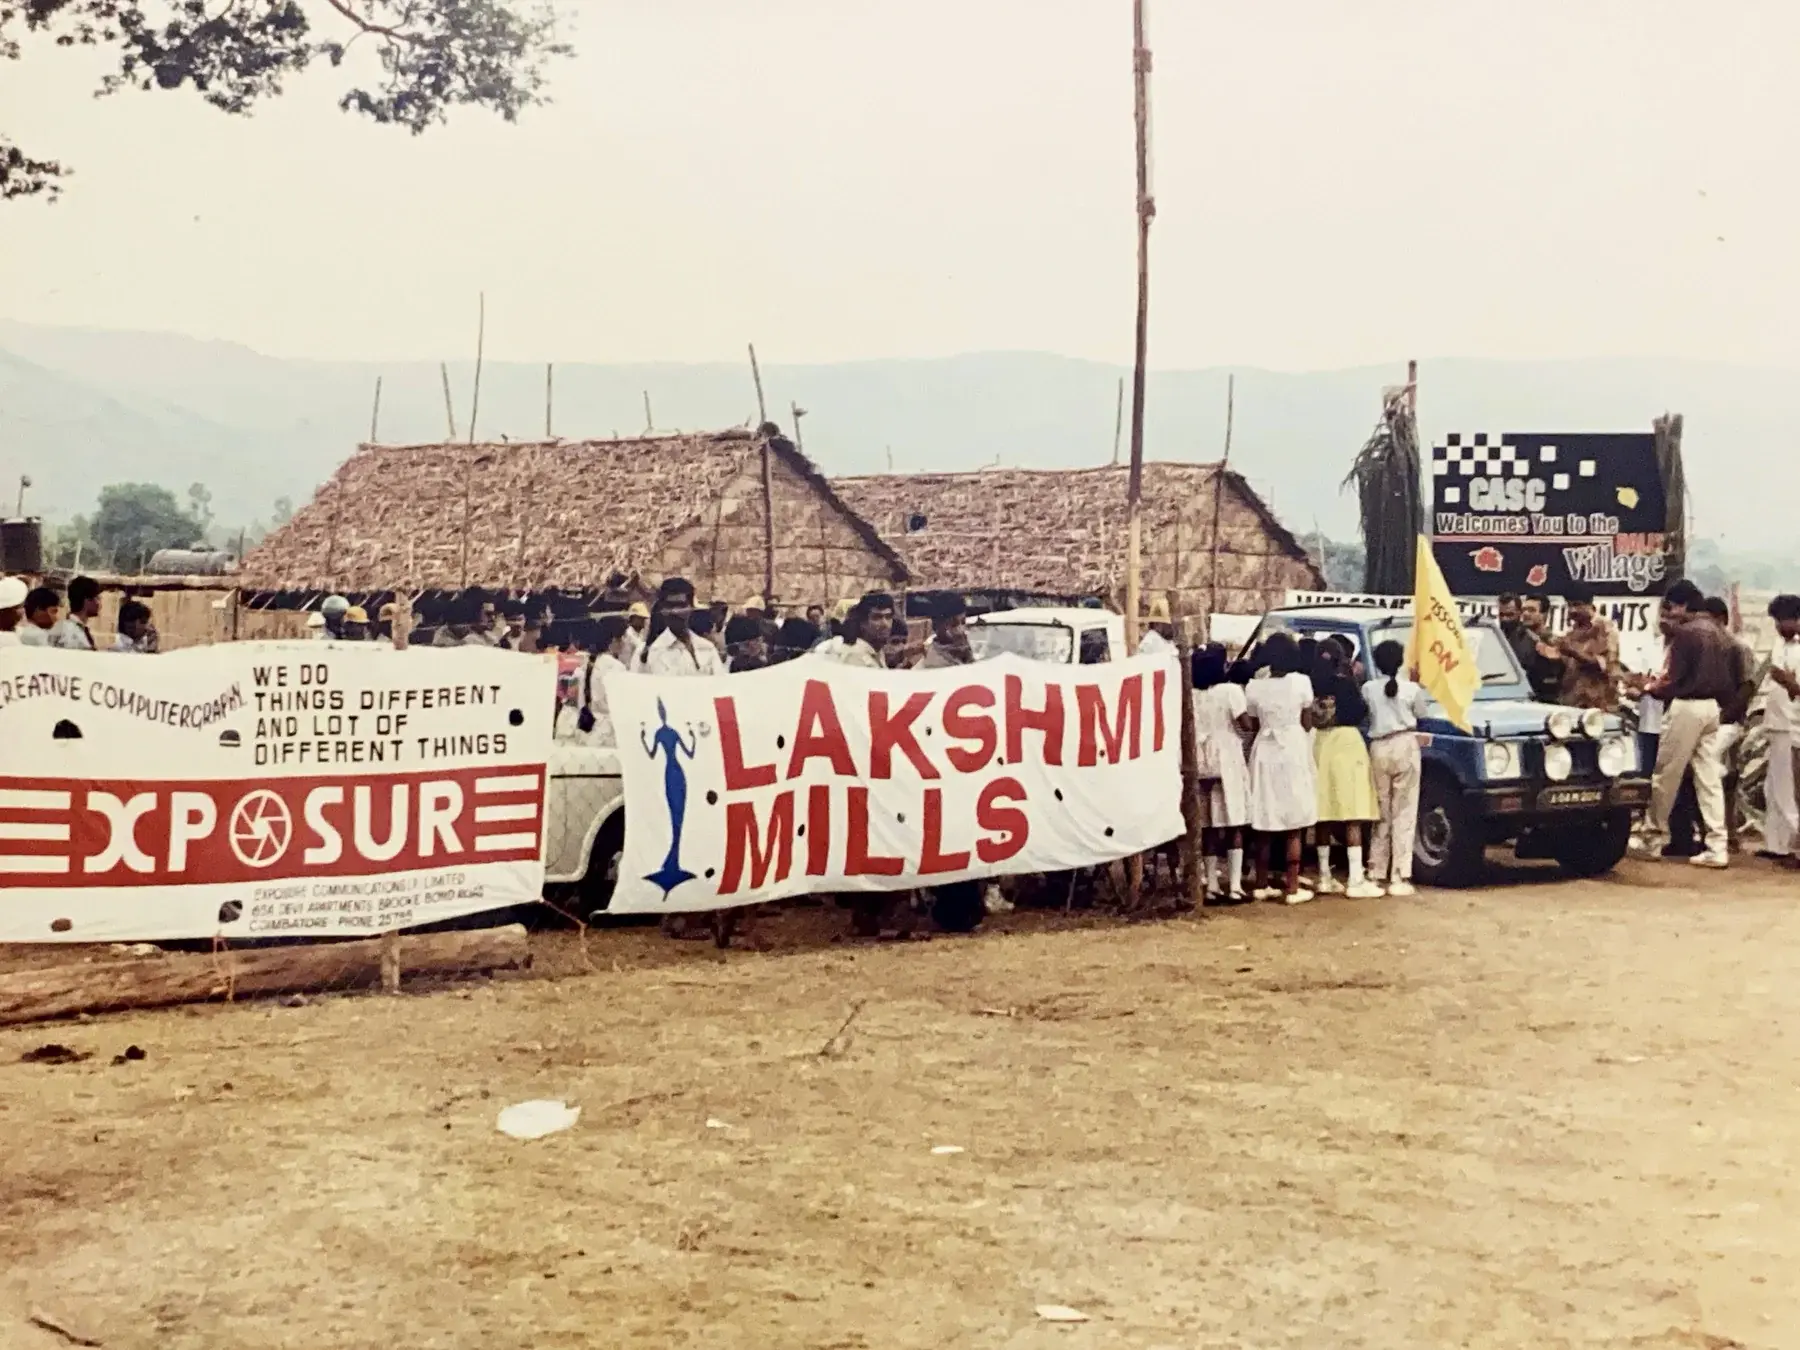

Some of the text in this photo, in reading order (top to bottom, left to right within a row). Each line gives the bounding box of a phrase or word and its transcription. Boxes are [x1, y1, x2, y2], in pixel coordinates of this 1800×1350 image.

[1436, 512, 1619, 533] Welcomes You to the
[1562, 543, 1667, 592] Village
[0, 673, 82, 709] REATIVE
[253, 664, 329, 687] WE DO
[255, 685, 501, 712] THINGS DIFFERENT
[256, 714, 408, 738] AND LOT OF
[714, 669, 1166, 791] LAKSHMI
[255, 734, 507, 766] DIFFERENT THINGS
[717, 776, 1029, 895] MILLS
